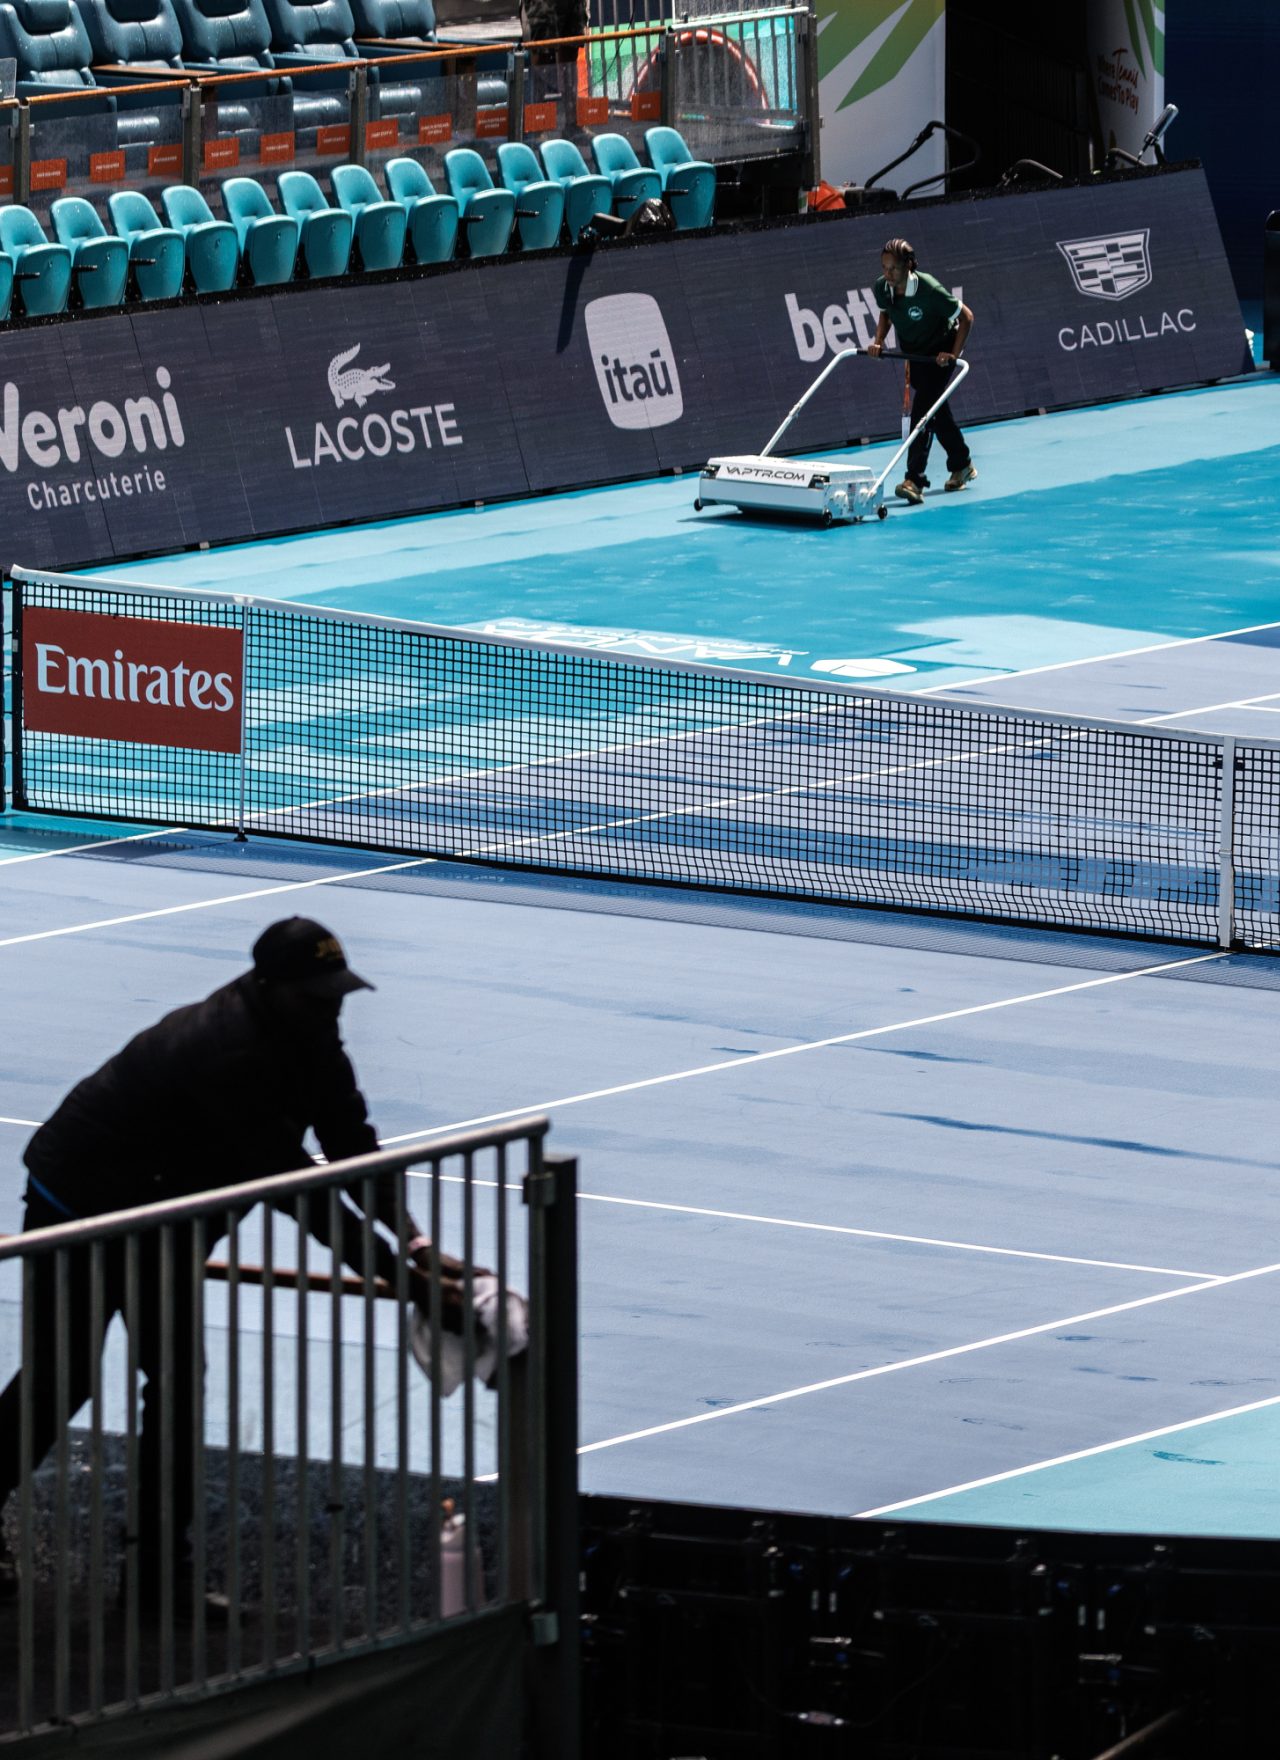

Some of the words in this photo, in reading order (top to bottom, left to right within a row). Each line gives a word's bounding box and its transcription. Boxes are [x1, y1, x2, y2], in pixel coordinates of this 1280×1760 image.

[1058, 309, 1196, 351] CADILLAC
[601, 348, 674, 403] itaú
[285, 403, 463, 469] LACOSTE
[27, 465, 166, 511] Charcuterie
[726, 466, 805, 481] VAPTR.COM
[35, 643, 234, 712] Emirates
